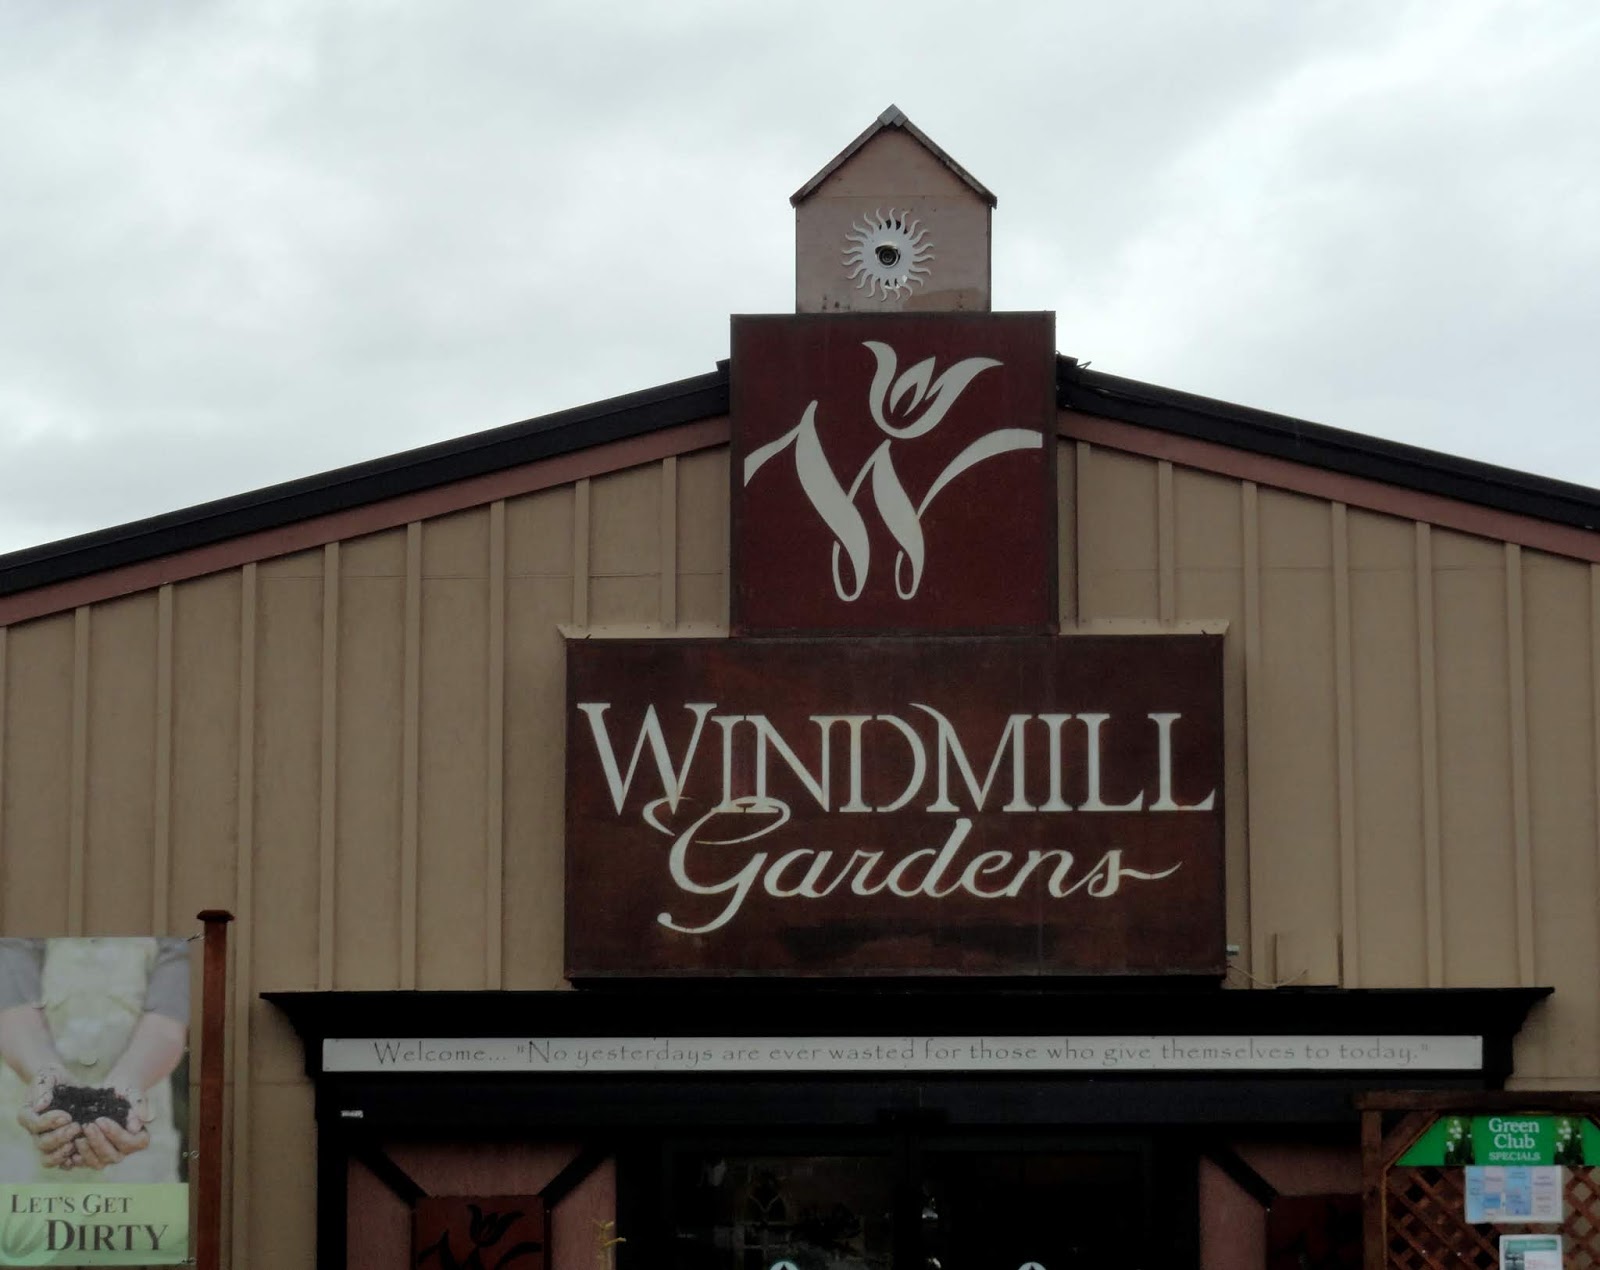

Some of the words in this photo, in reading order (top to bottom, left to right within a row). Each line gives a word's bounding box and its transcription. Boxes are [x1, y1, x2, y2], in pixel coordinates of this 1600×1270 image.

[577, 702, 1216, 815] WINDMILL
[642, 796, 1182, 934] Gardens
[577, 1040, 713, 1068] yesterdays
[722, 1048, 760, 1061] are
[769, 1048, 823, 1061] ever
[829, 1038, 915, 1061] wasted
[925, 1038, 960, 1061] for
[969, 1038, 1037, 1061] those
[1047, 1038, 1094, 1061] who
[1102, 1042, 1151, 1067] give
[1161, 1038, 1295, 1061] themselves
[1305, 1043, 1330, 1060] to
[1488, 1117, 1540, 1133] Green
[1493, 1133, 1536, 1149] Club
[1488, 1151, 1541, 1161] SPECIALS
[11, 1194, 76, 1213] LET'S
[82, 1193, 133, 1216] GET
[46, 1219, 169, 1251] DIRTY
